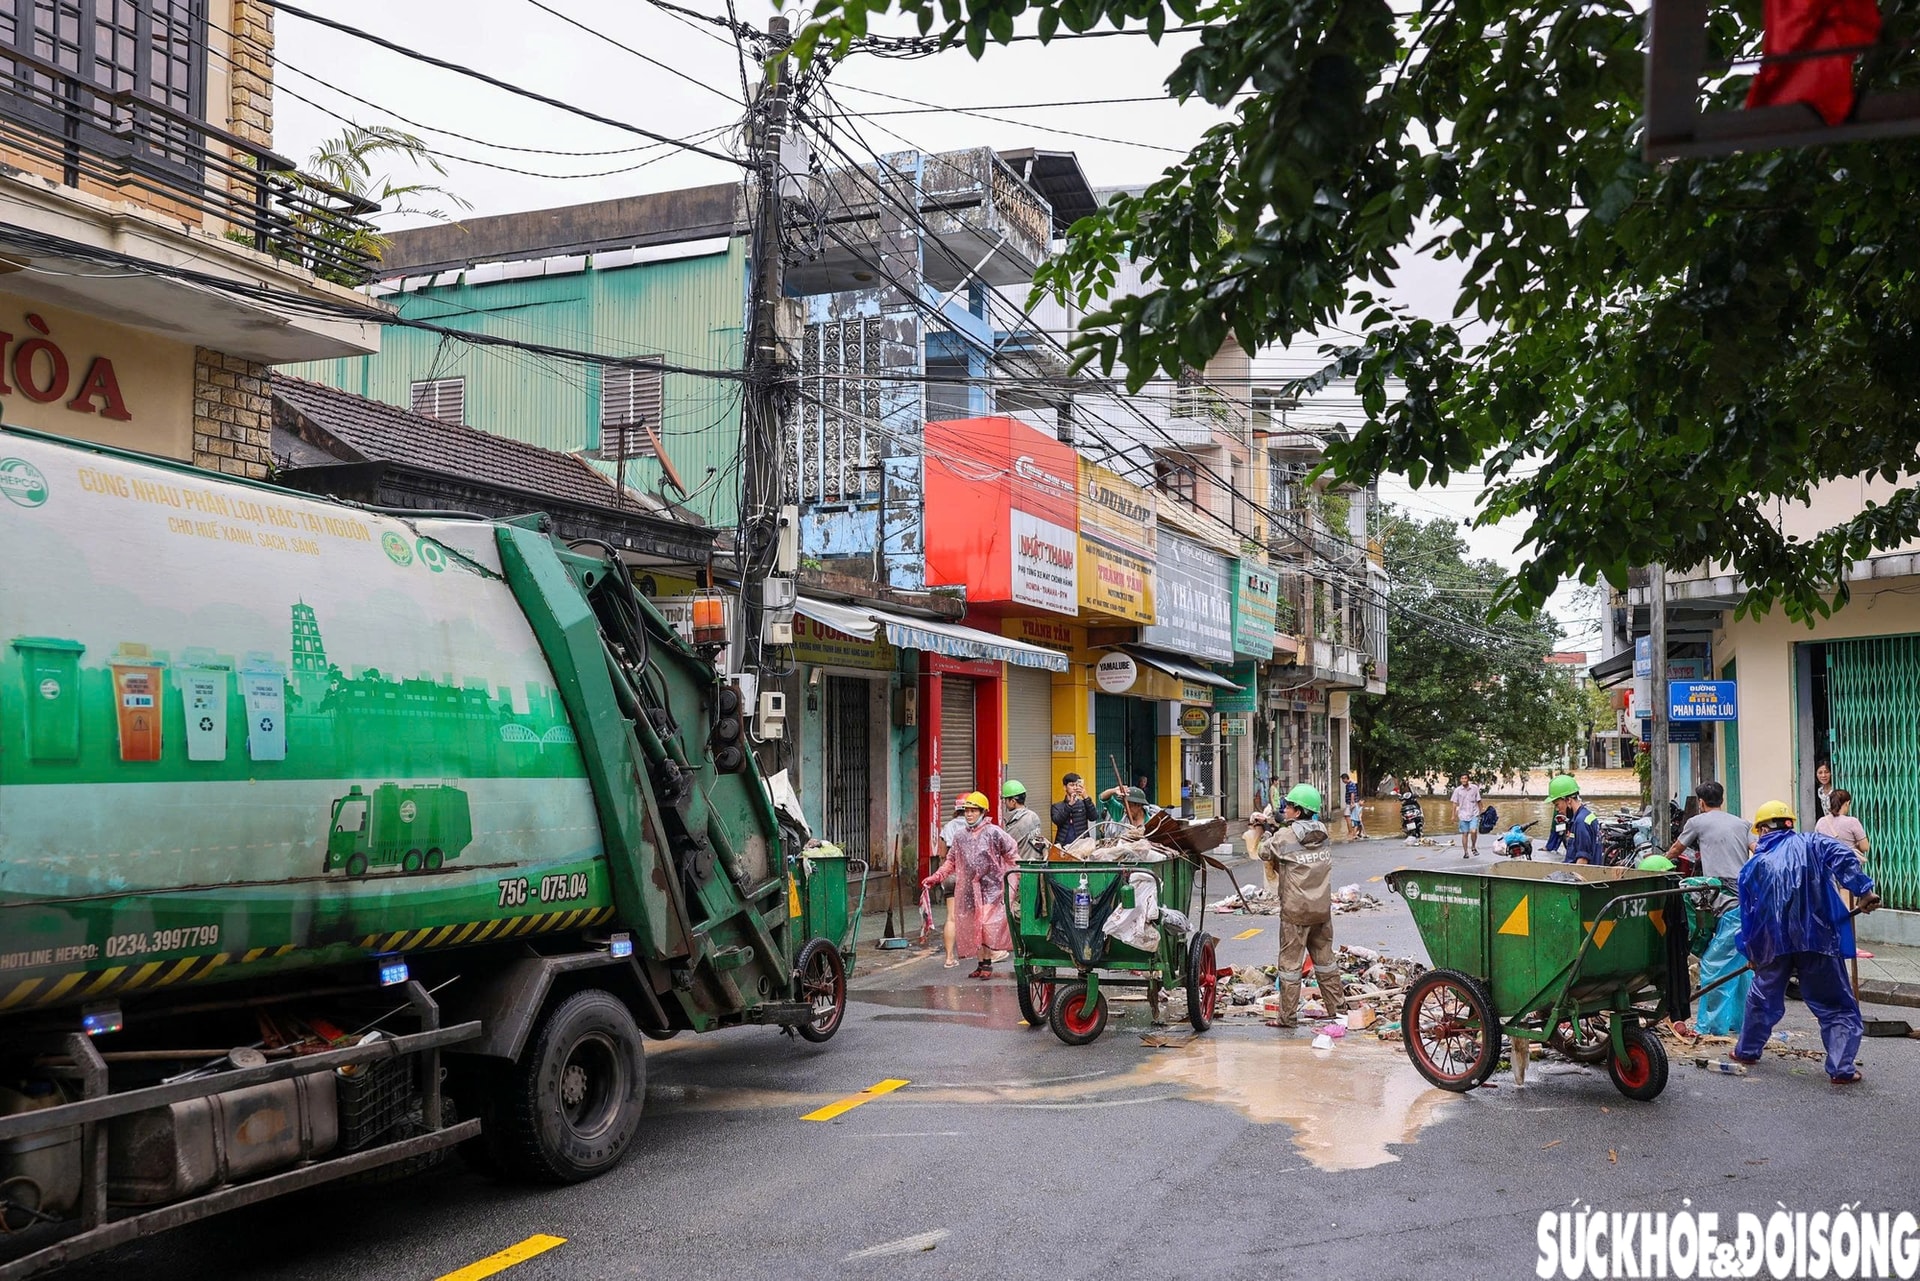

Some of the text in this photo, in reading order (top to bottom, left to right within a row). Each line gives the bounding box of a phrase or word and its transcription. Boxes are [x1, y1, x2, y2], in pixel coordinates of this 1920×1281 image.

[78, 467, 129, 498] CÙNG
[131, 478, 181, 508] NHAU
[230, 499, 265, 526] LOẠI
[266, 505, 298, 529] RÁC
[298, 512, 323, 536] TẠI
[1100, 486, 1151, 522] DUNLOP
[168, 516, 193, 535] CHO
[195, 520, 219, 539] HUẾ
[1018, 533, 1044, 565] NHẬT
[1098, 564, 1125, 588] THÀNH
[1172, 580, 1209, 618] THÀNH
[1210, 593, 1231, 625] TÂM
[1022, 617, 1071, 643] THÀNH TÂM
[1100, 661, 1130, 671] YAMALUBE
[1689, 684, 1717, 692] ĐƯỜNG
[1672, 702, 1734, 716] PHAN ĐĂNG LƯU
[498, 878, 528, 907] 75C
[541, 873, 587, 902] 075.04
[1, 925, 219, 969] HOTLINE HEPCO: 0234.3997799
